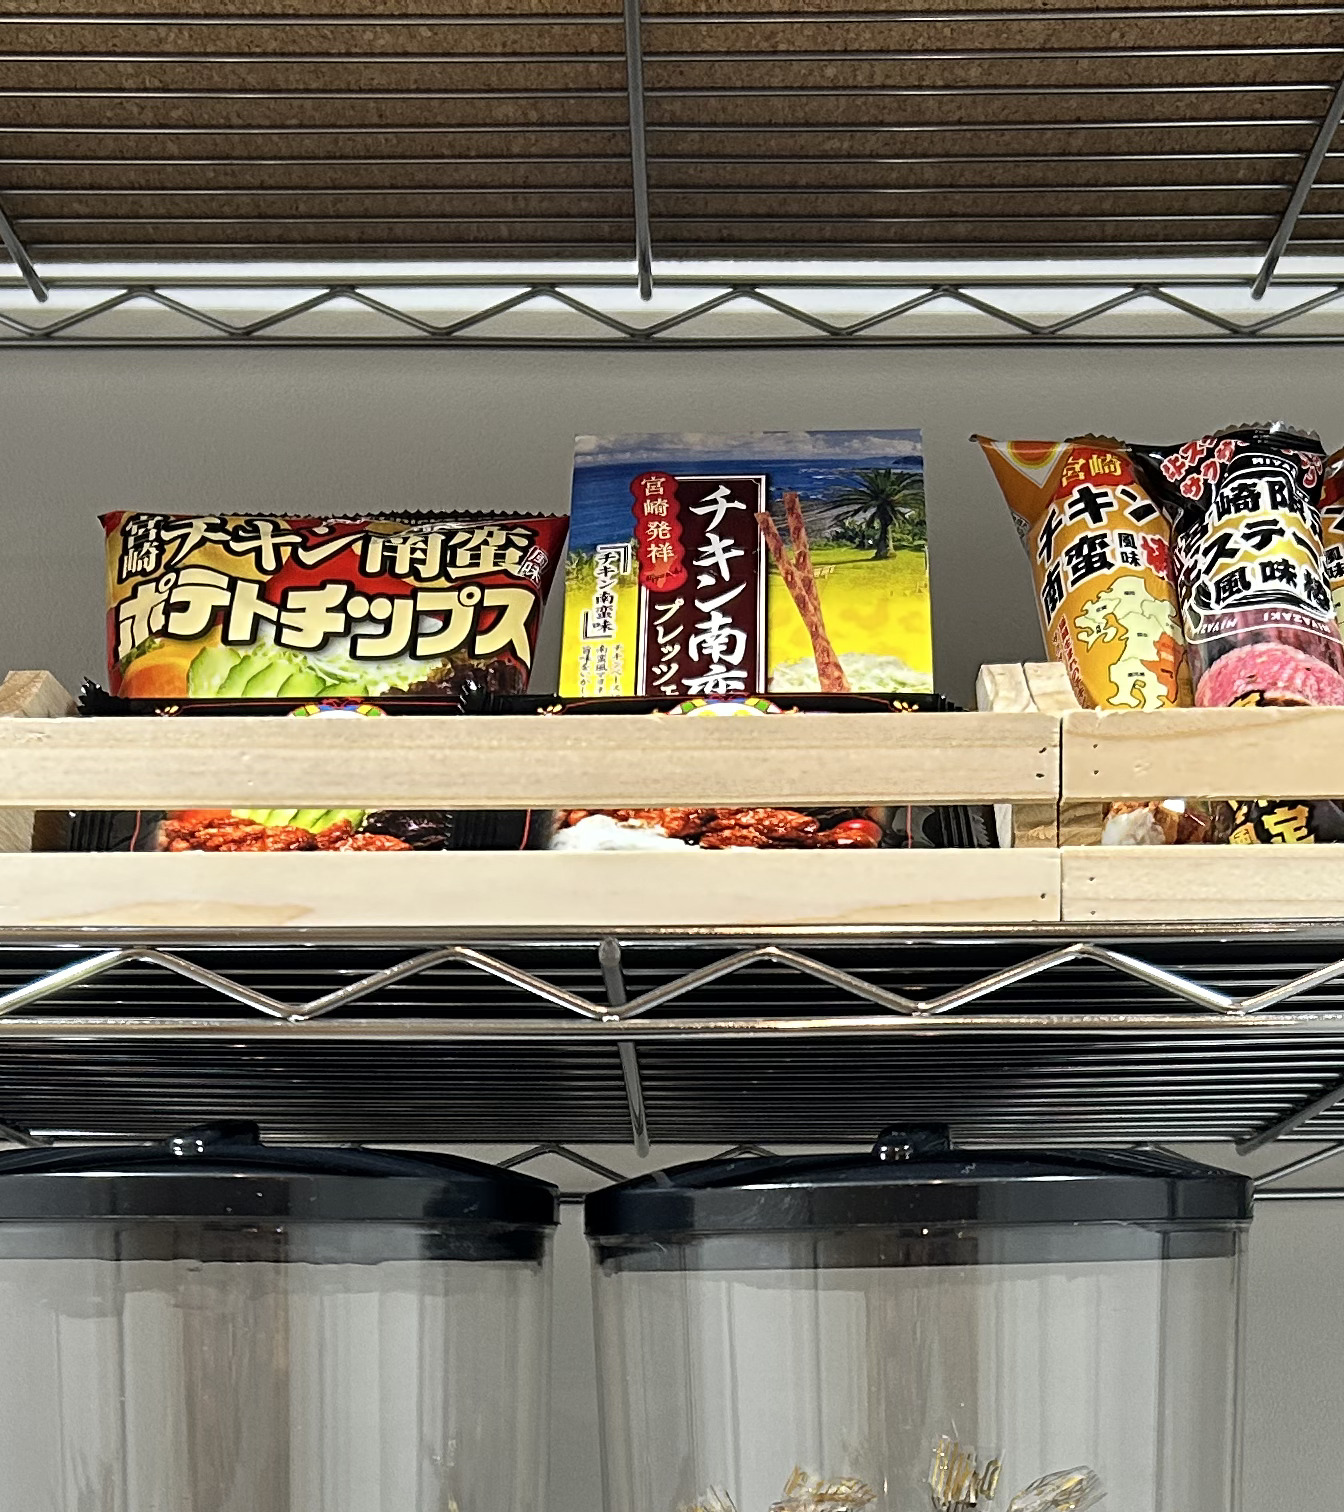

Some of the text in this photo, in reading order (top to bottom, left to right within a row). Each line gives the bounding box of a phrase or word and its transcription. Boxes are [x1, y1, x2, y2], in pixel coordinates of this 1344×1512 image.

[1062, 454, 1123, 488] 宮崎
[161, 516, 533, 579] チキン南蛮
[640, 476, 676, 564] 宮崎発祥
[117, 568, 536, 669] ポテトチップス
